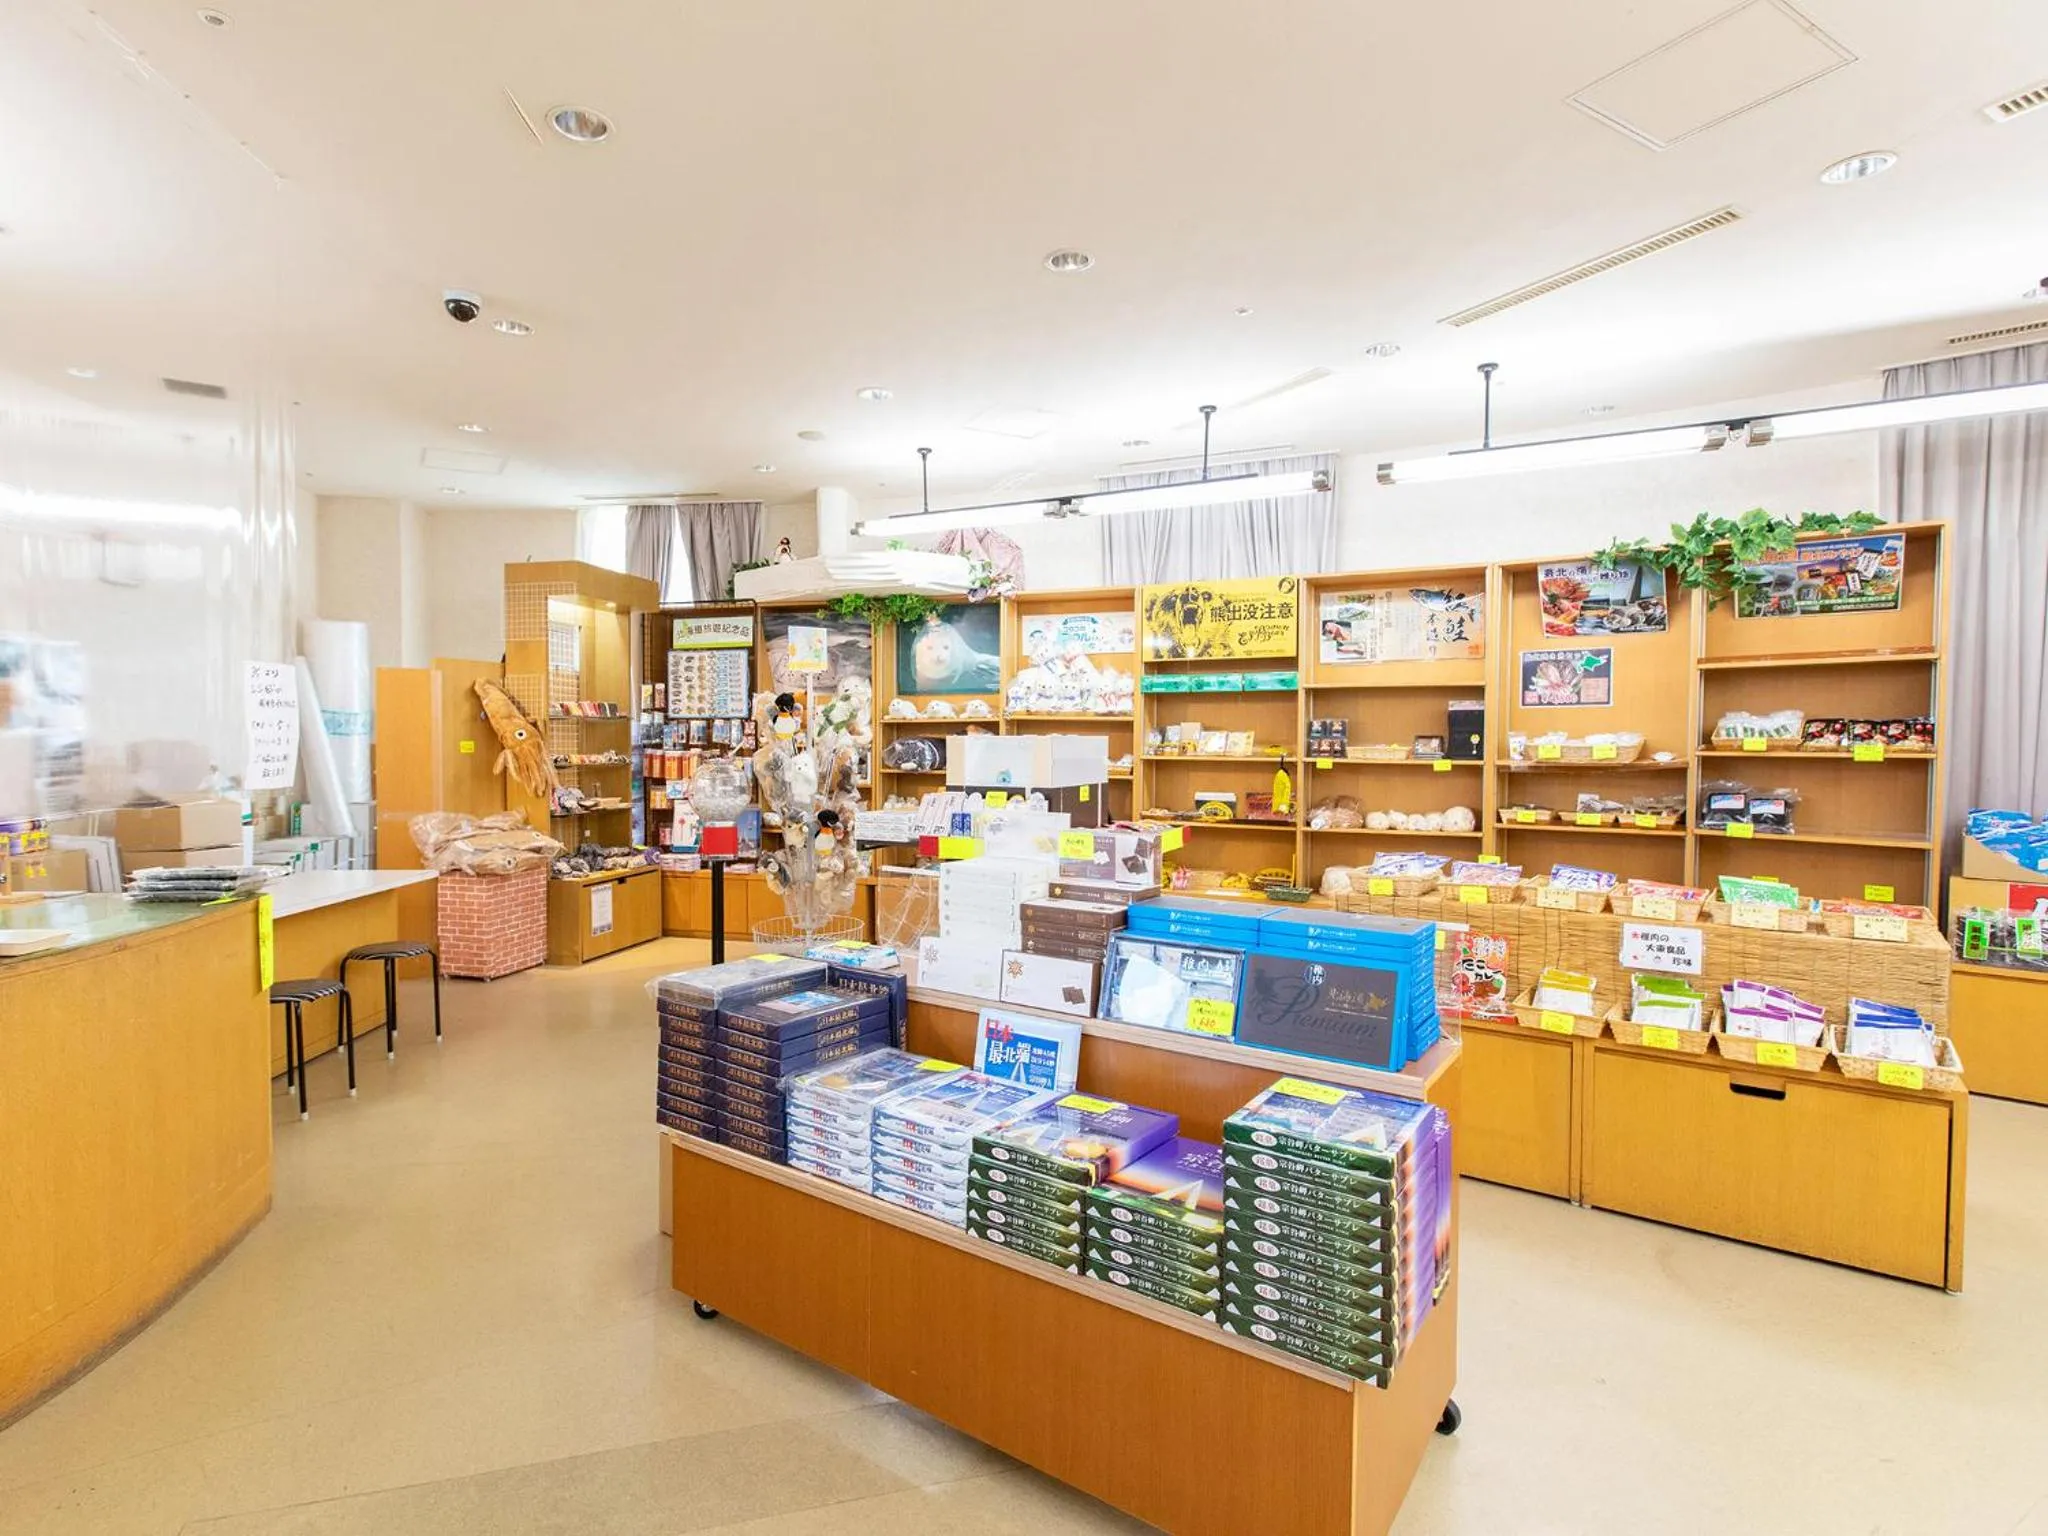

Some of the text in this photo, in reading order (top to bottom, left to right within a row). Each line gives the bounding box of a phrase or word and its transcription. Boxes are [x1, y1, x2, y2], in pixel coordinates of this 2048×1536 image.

[1210, 601, 1294, 622] 熊出没注意
[1461, 958, 1486, 971] たこ
[1474, 969, 1503, 981] カレー
[1255, 969, 1378, 1041] Premium
[985, 1018, 1014, 1043] 日本
[989, 1040, 1031, 1064] 最北端
[1278, 1135, 1357, 1161] 宗谷岬バターサブレ
[1279, 1159, 1357, 1184] 宗谷岬バターサブレ
[1281, 1181, 1360, 1208] 宗谷岬バターサブレ
[1281, 1203, 1360, 1231] 宗谷岬バターサブレ
[1281, 1225, 1360, 1253] 宗谷岬バターサブレ
[1280, 1247, 1359, 1276] 宗谷岬バターサブレ
[1281, 1268, 1359, 1299] 宗谷岬バターサブレ
[1282, 1290, 1360, 1322] 宗谷岬バターサブレ
[1280, 1312, 1359, 1344] 宗谷岬バターサブレ
[1278, 1332, 1357, 1365] 宗谷岬バターサブレ
